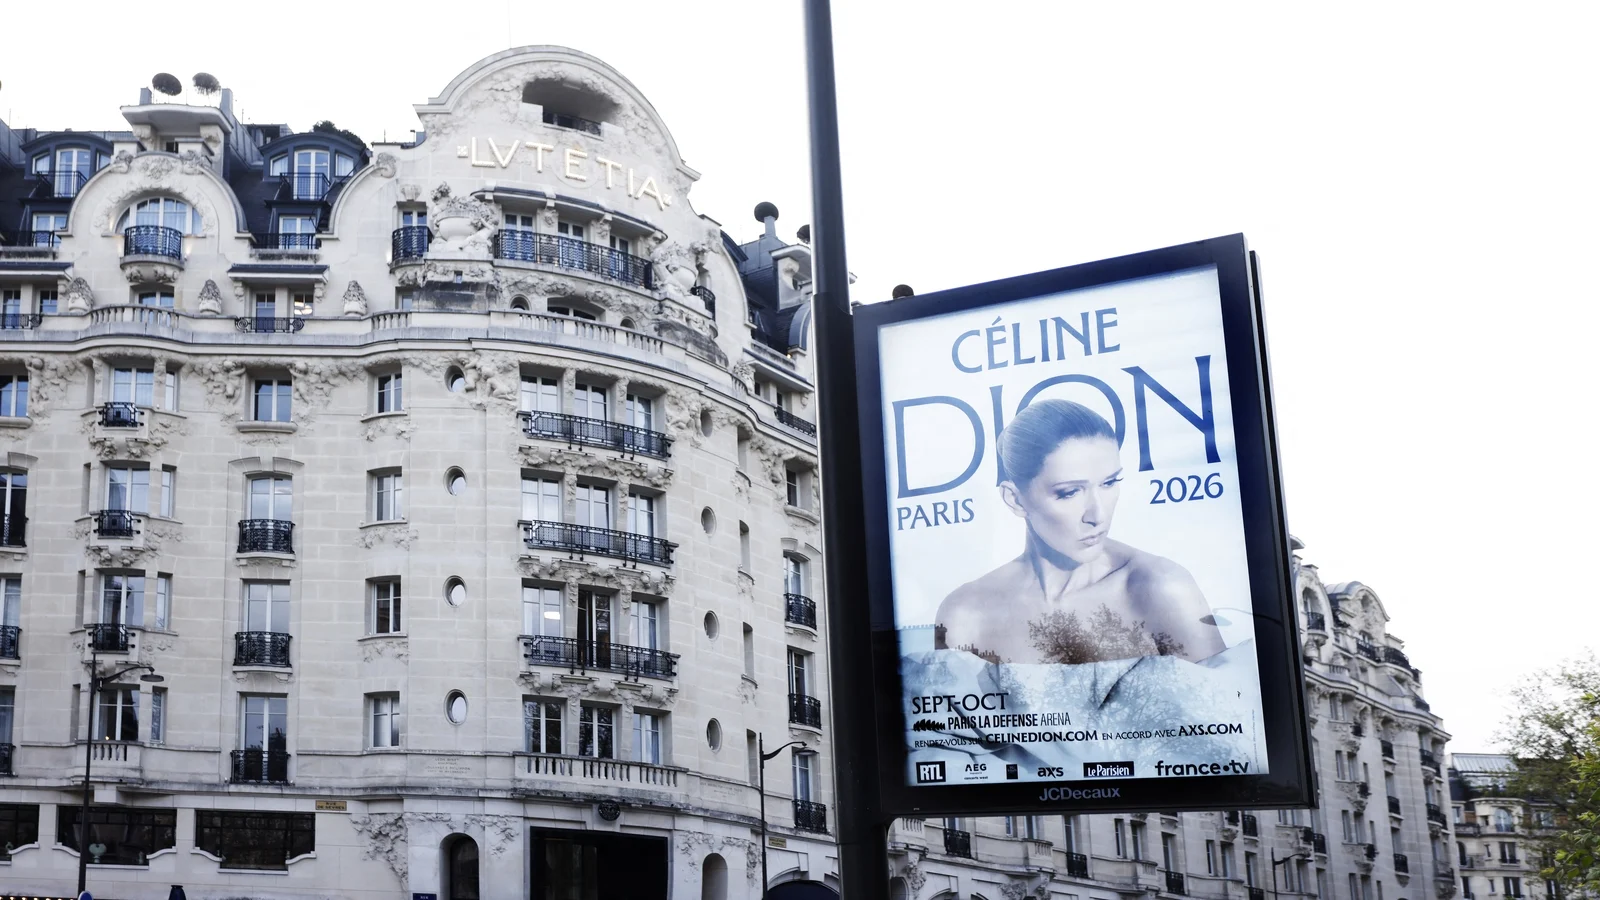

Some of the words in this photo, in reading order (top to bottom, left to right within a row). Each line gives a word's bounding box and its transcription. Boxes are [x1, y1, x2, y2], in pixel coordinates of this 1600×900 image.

[471, 136, 666, 211] LVTETIA
[951, 307, 1121, 373] CÉLINE
[1150, 472, 1224, 505] 2026
[897, 498, 975, 531] PARIS
[912, 693, 1009, 714] SEPT-OCT
[948, 715, 977, 730] PARIS
[978, 715, 991, 729] LA
[993, 713, 1038, 728] DEFENSE
[1040, 712, 1071, 727] ARENA
[914, 738, 967, 748] RENDEZ-VOUS
[986, 730, 1098, 744] CELINEDION.COM
[1102, 732, 1113, 740] EN
[1115, 730, 1152, 740] ACCORD
[1154, 729, 1177, 738] AVEC
[1178, 723, 1243, 737] AXS.COM
[919, 764, 944, 781] RTL
[965, 763, 987, 772] AEG
[1037, 766, 1064, 778] axs
[1039, 787, 1121, 801] JCDecaux
